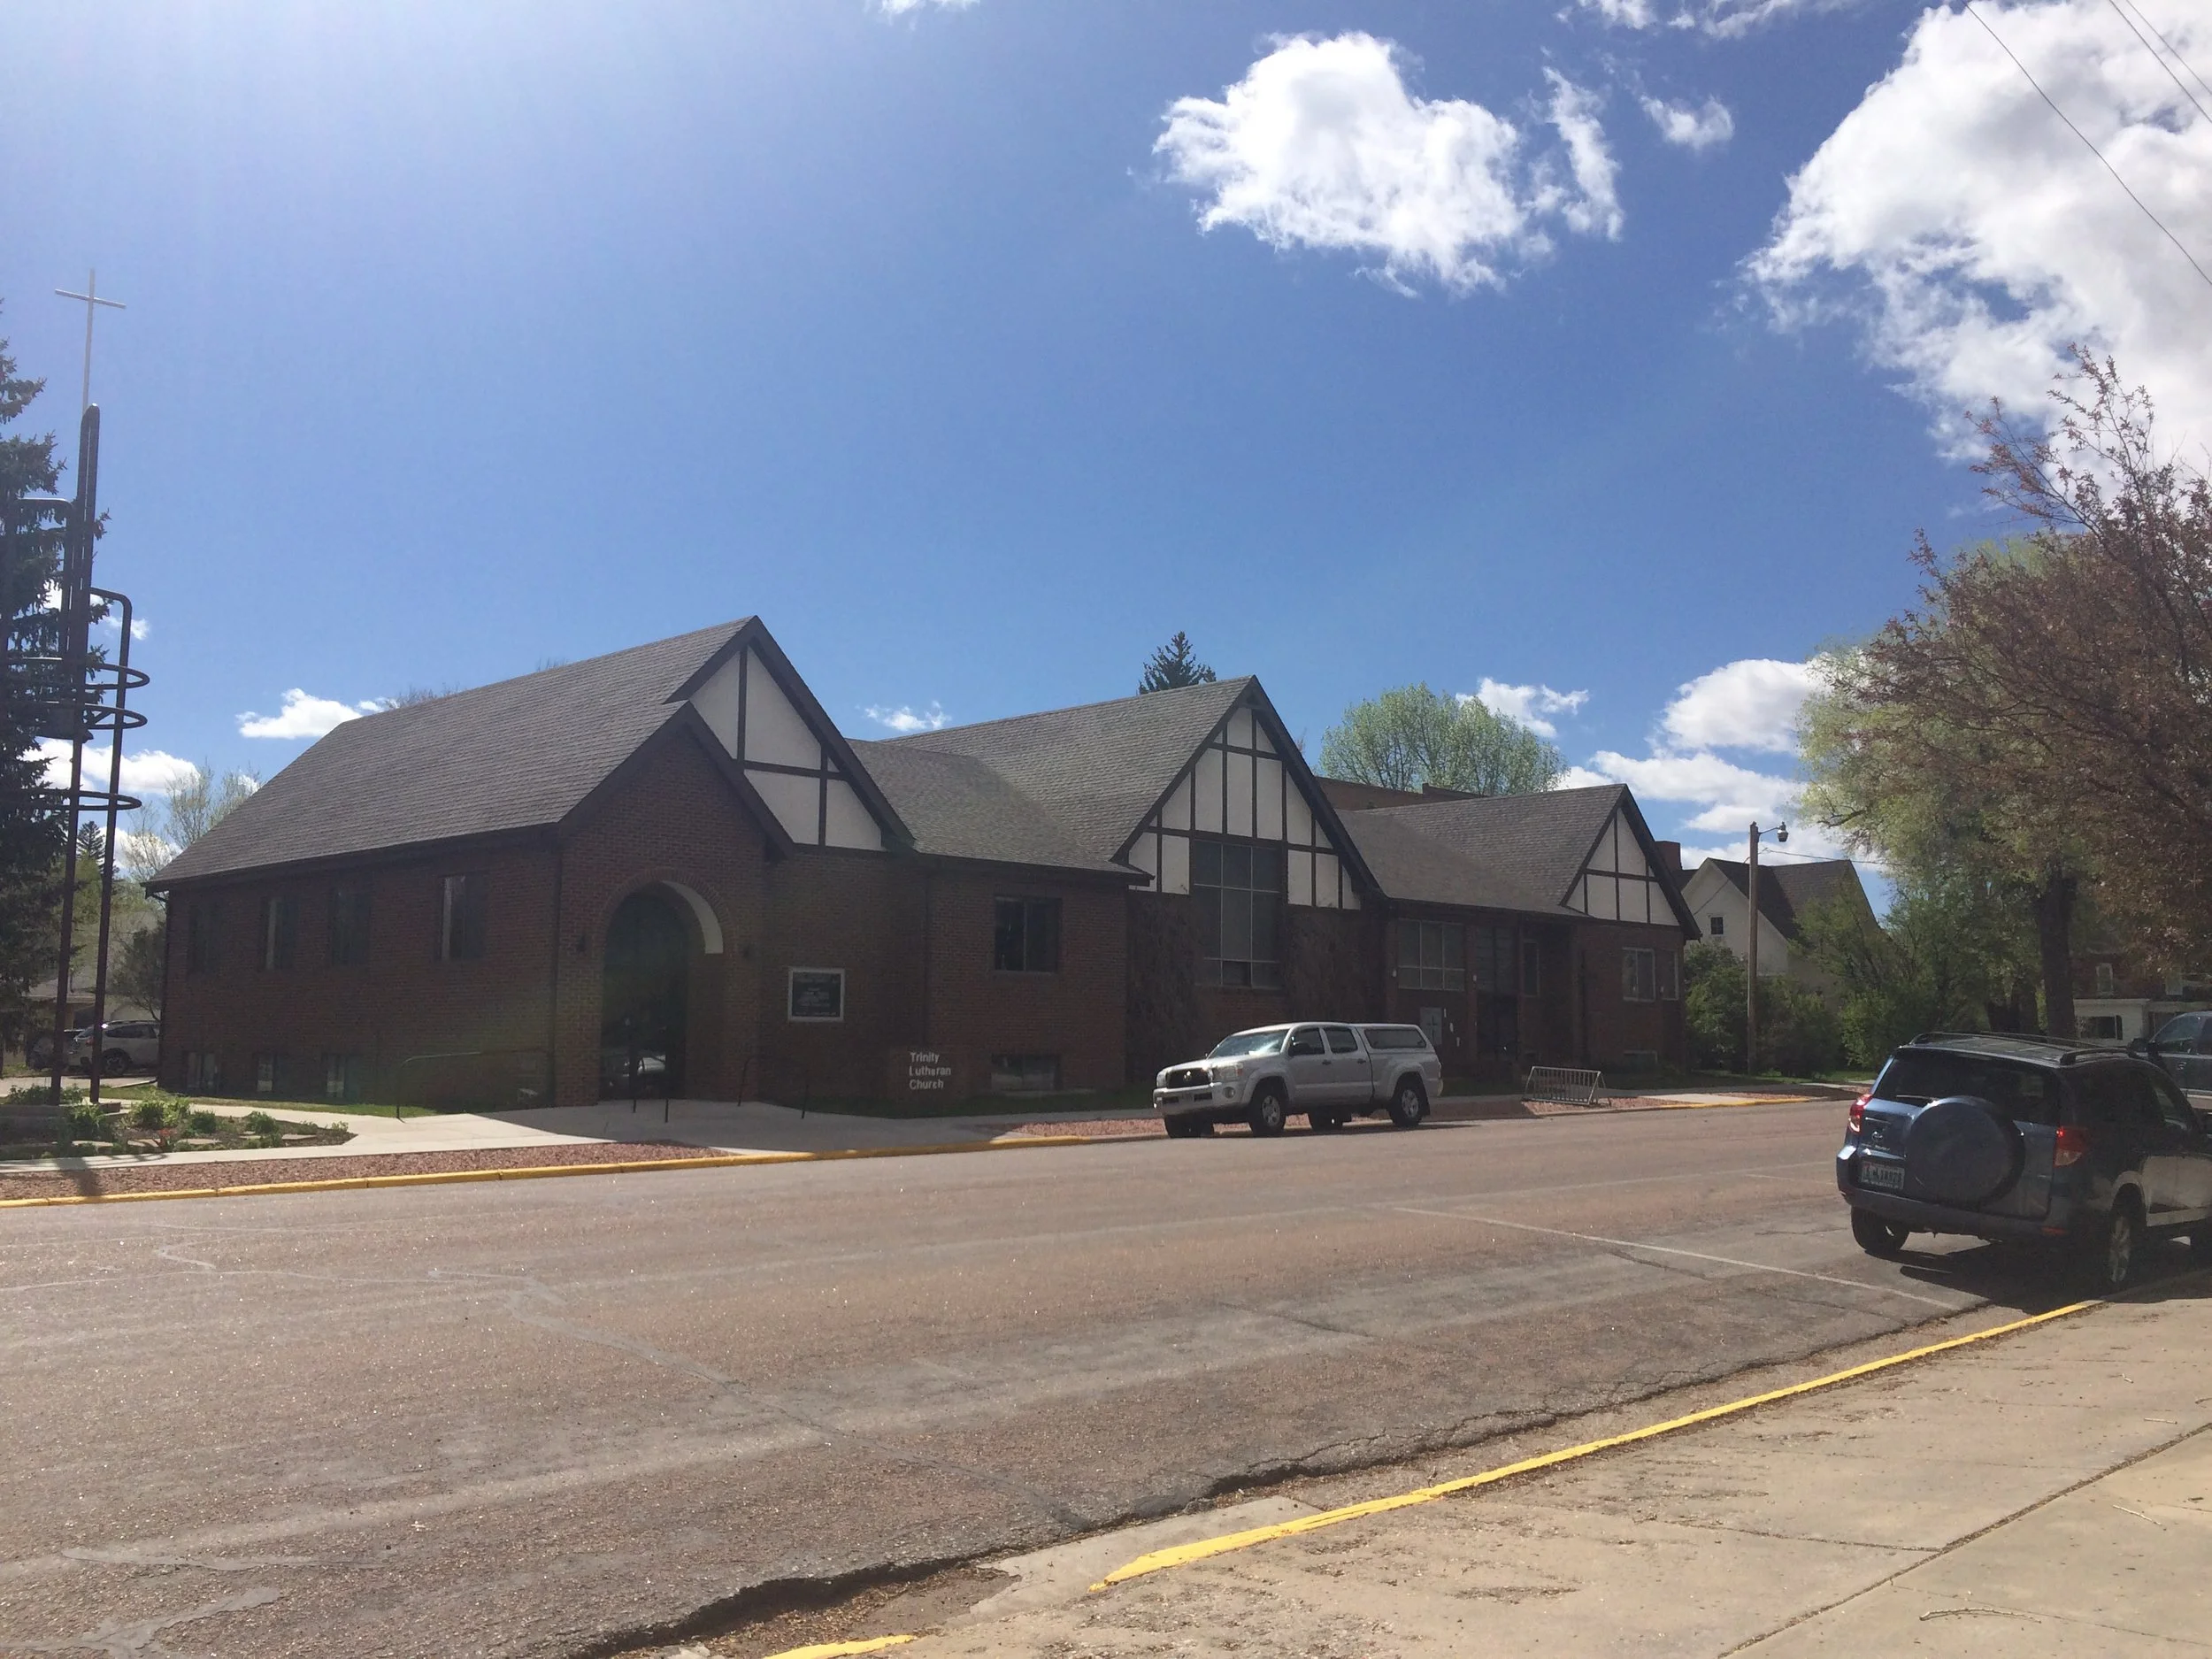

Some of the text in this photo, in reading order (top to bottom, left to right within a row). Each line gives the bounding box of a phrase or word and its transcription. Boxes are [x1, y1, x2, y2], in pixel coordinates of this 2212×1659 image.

[910, 1051, 940, 1064] Trinity
[909, 1065, 951, 1077] Lutheran
[909, 1079, 944, 1090] Church
